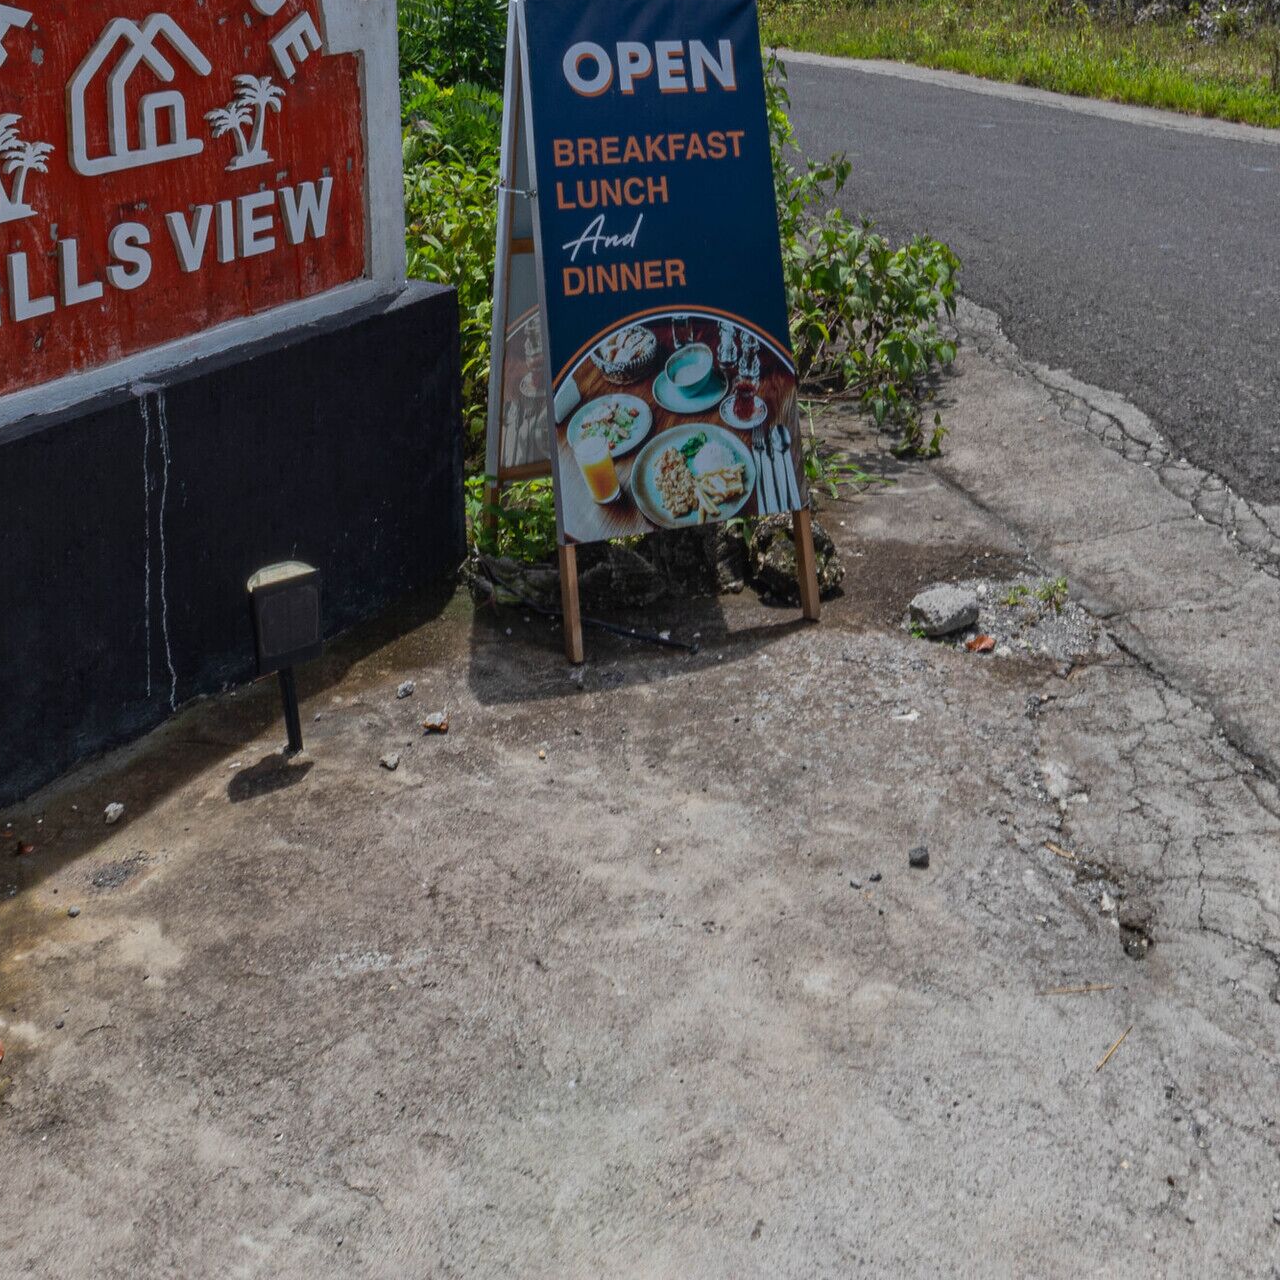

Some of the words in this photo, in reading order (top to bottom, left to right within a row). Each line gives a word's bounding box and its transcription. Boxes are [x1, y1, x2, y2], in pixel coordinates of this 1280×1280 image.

[562, 39, 738, 98] OPEN
[553, 131, 745, 167] BREAKFAST
[556, 176, 669, 210] LUNCH
[166, 176, 333, 273] VIEW
[562, 212, 644, 262] And
[562, 259, 687, 296] DINNER
